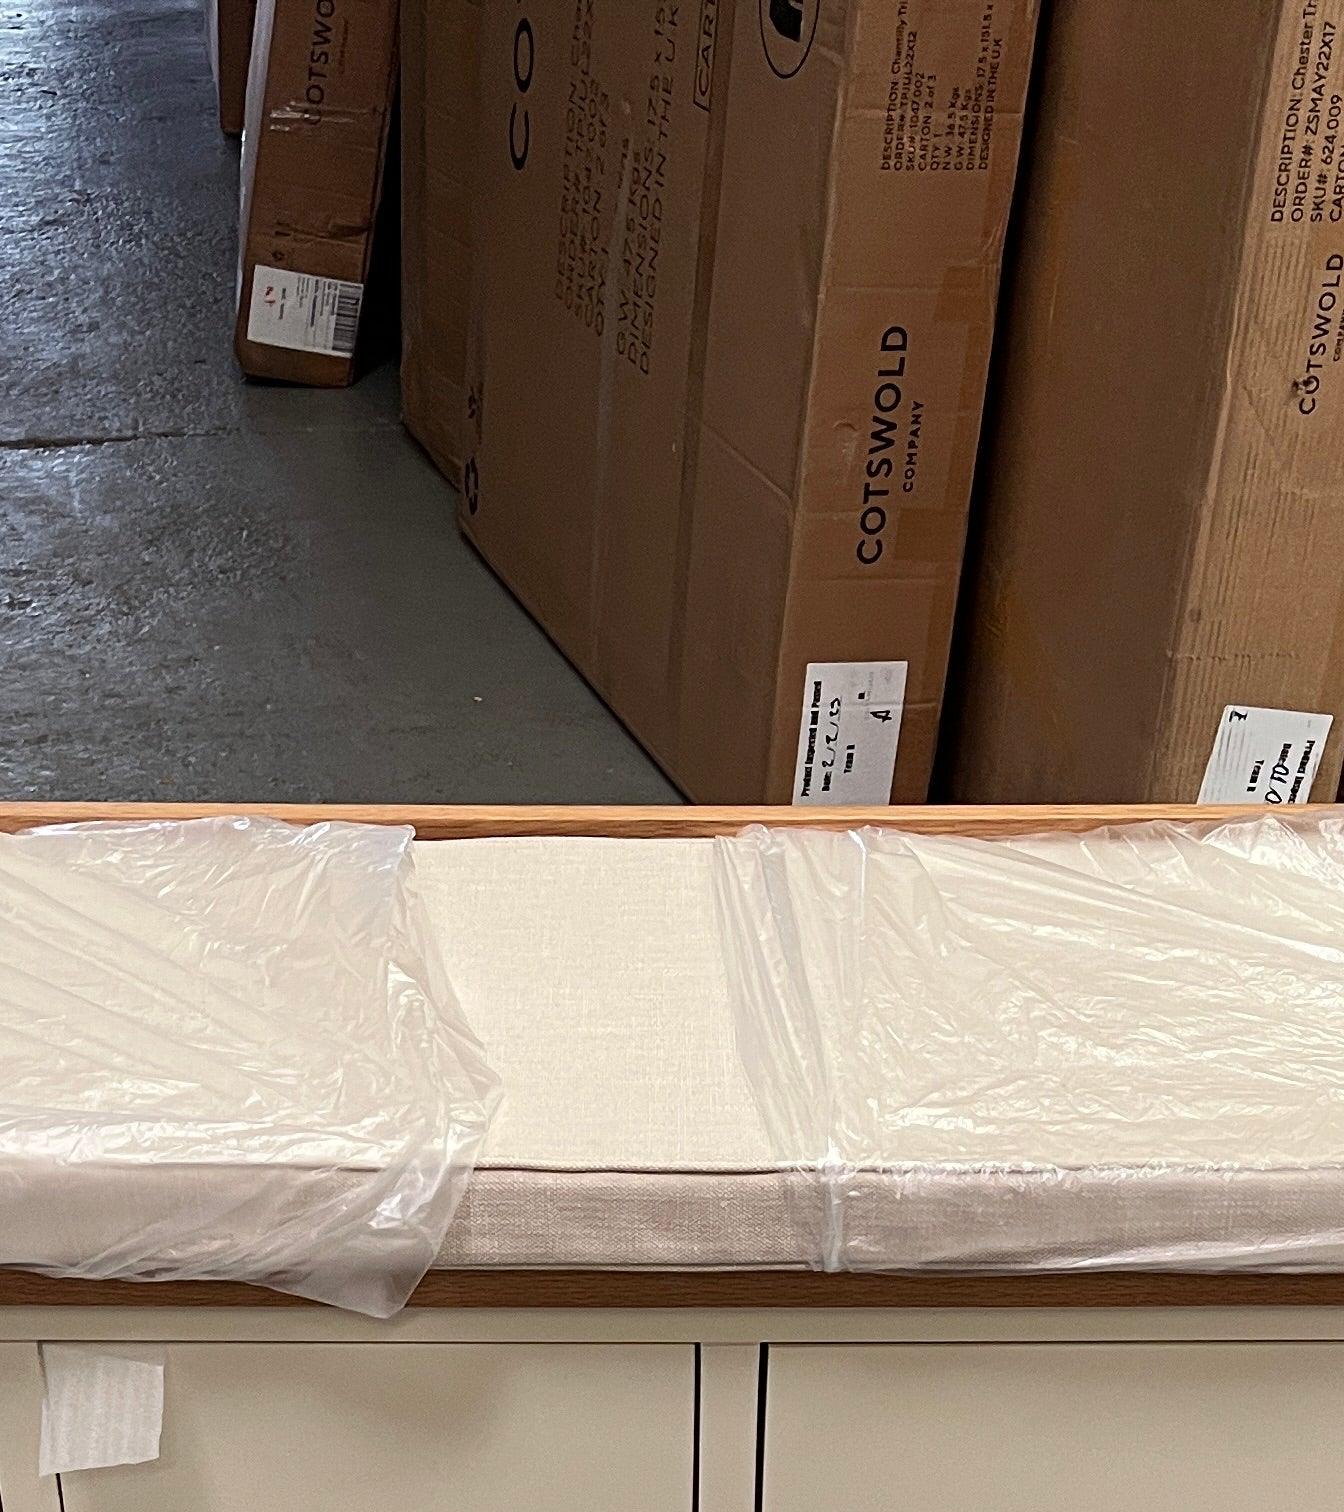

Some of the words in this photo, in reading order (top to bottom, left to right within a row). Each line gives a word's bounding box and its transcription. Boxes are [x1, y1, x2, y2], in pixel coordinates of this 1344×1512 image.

[986, 89, 996, 103] IN
[988, 62, 1000, 86] THE
[1291, 22, 1313, 90] Chester
[1305, 21, 1336, 136] ZSMAY22X17
[979, 105, 994, 170] DESIGNED
[1299, 253, 1344, 415] COTSWOLD
[856, 326, 908, 565] COTSWOLD
[902, 400, 924, 493] COMPANY
